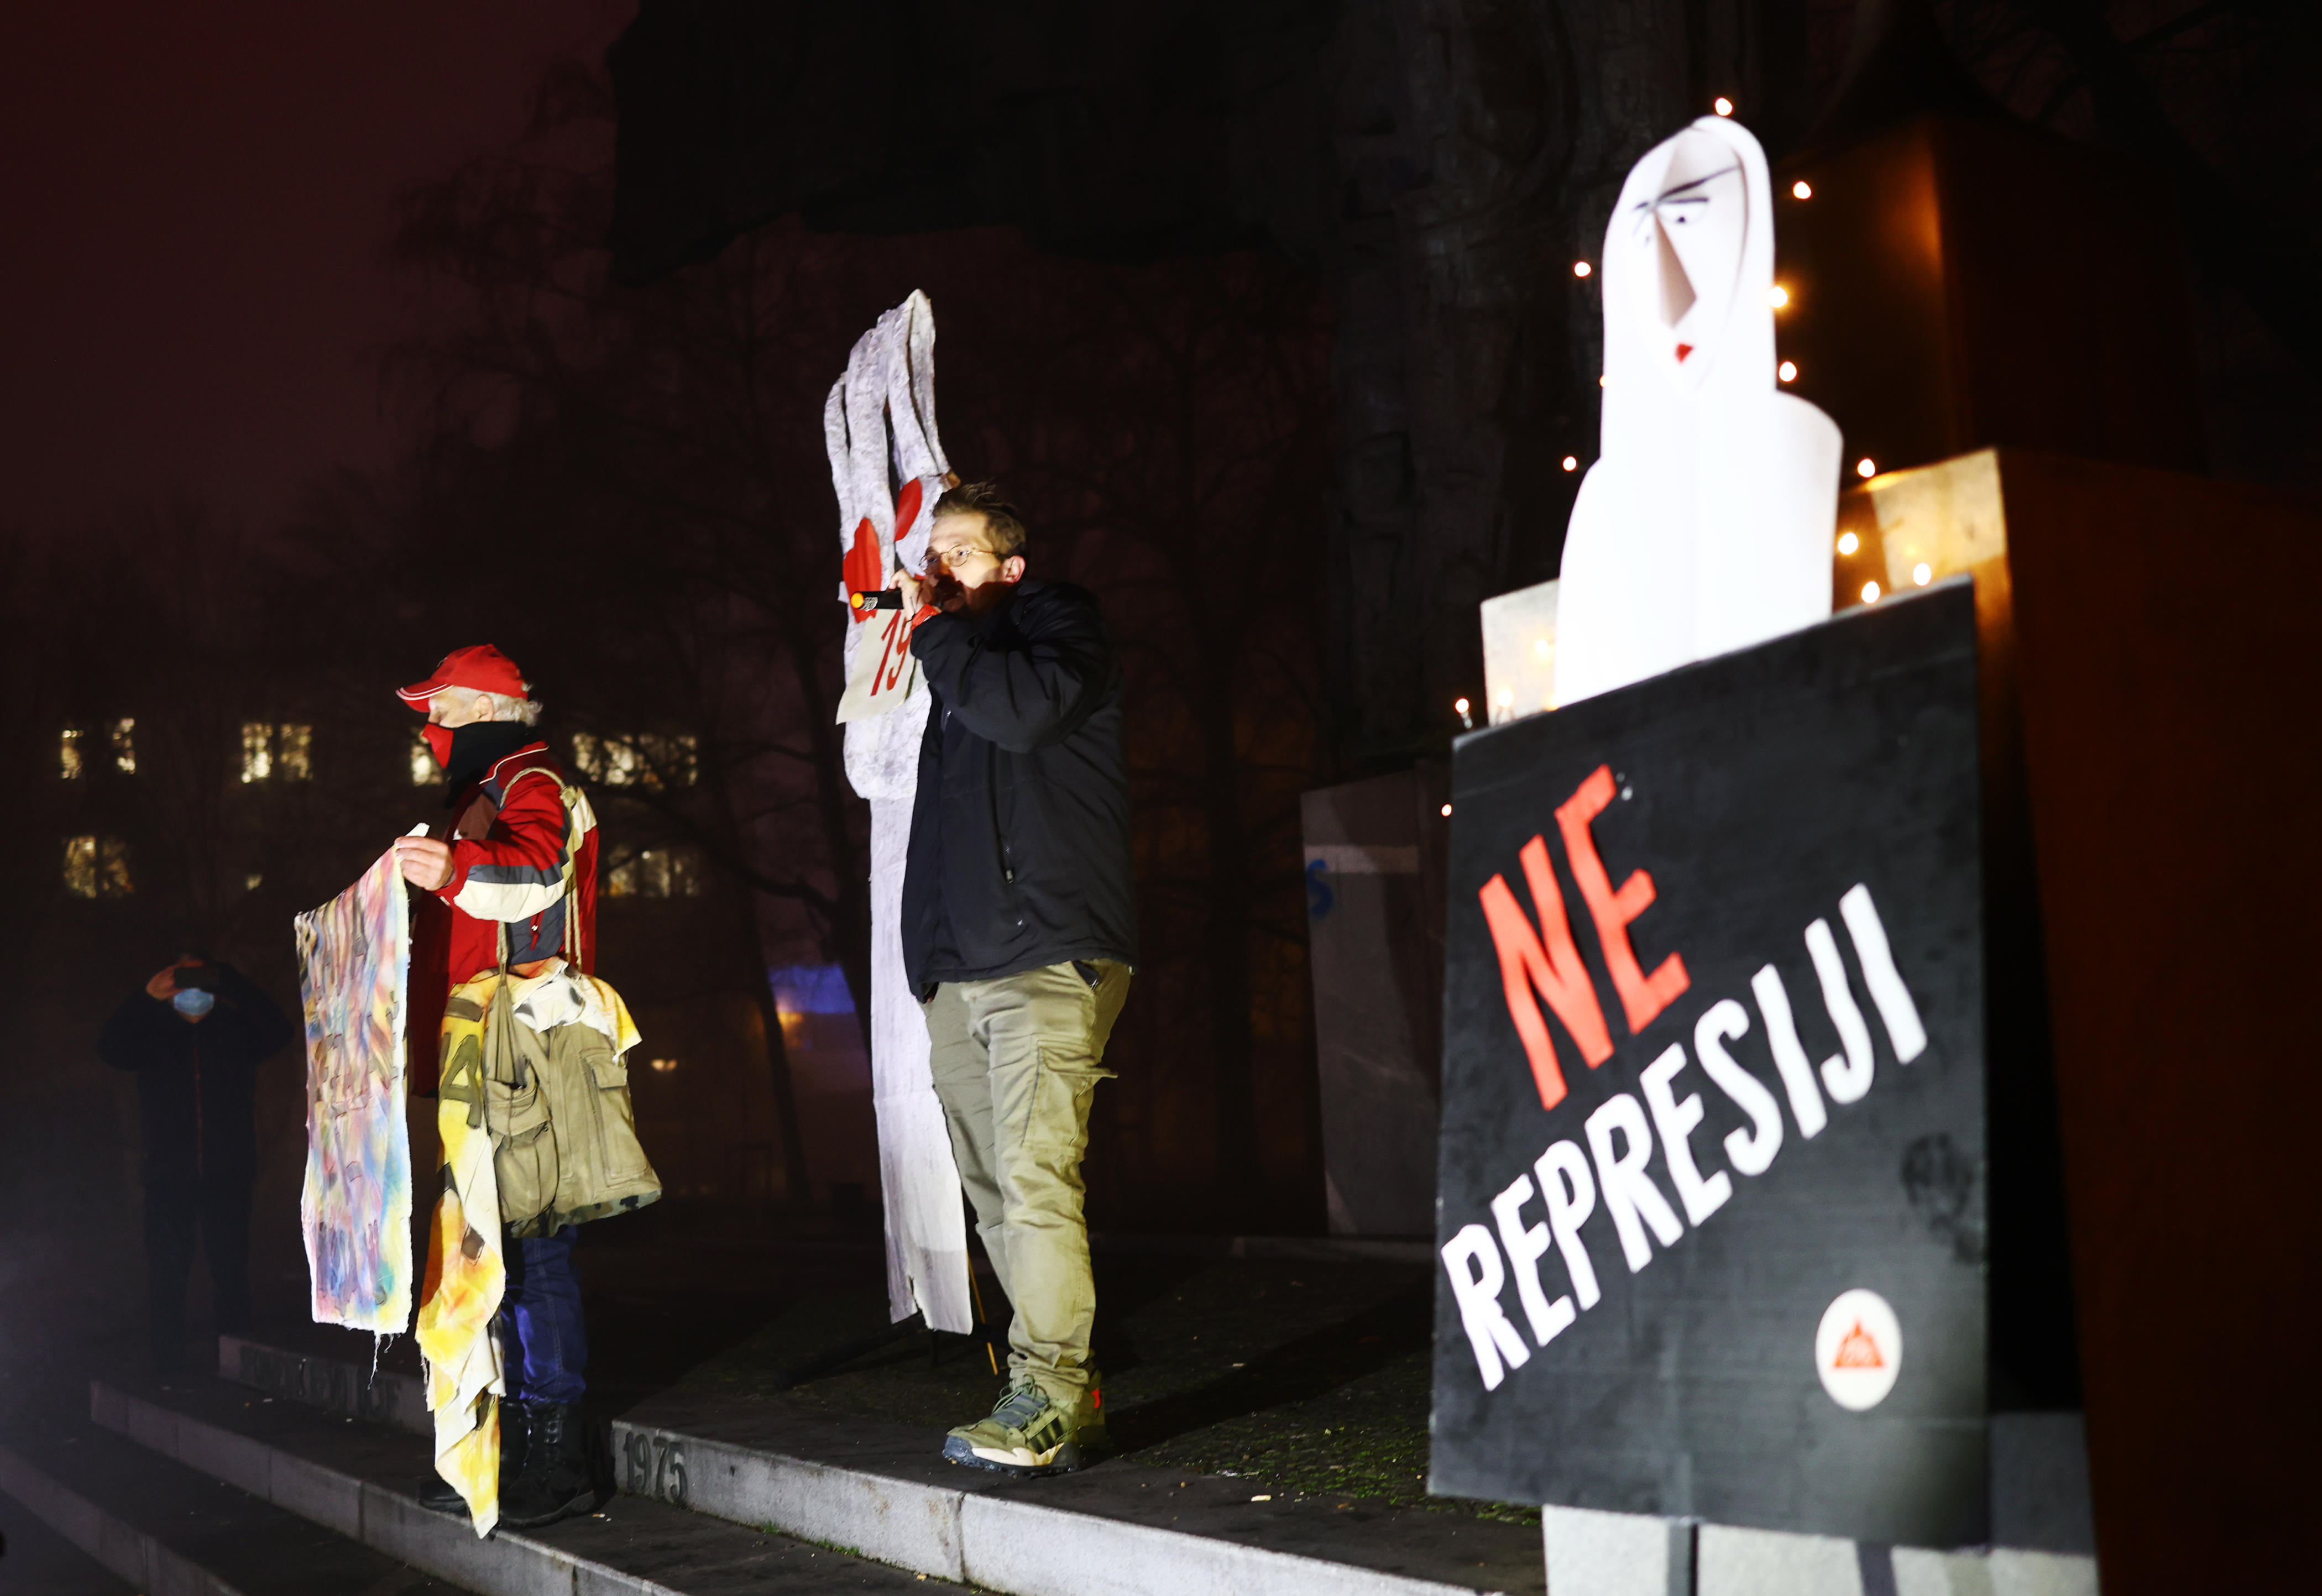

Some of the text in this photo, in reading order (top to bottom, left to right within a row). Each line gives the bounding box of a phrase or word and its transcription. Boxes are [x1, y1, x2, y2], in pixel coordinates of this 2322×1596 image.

[1478, 765, 1690, 1111] NE
[1441, 883, 1927, 1391] REPRESIJI
[623, 1431, 688, 1503] 1975
